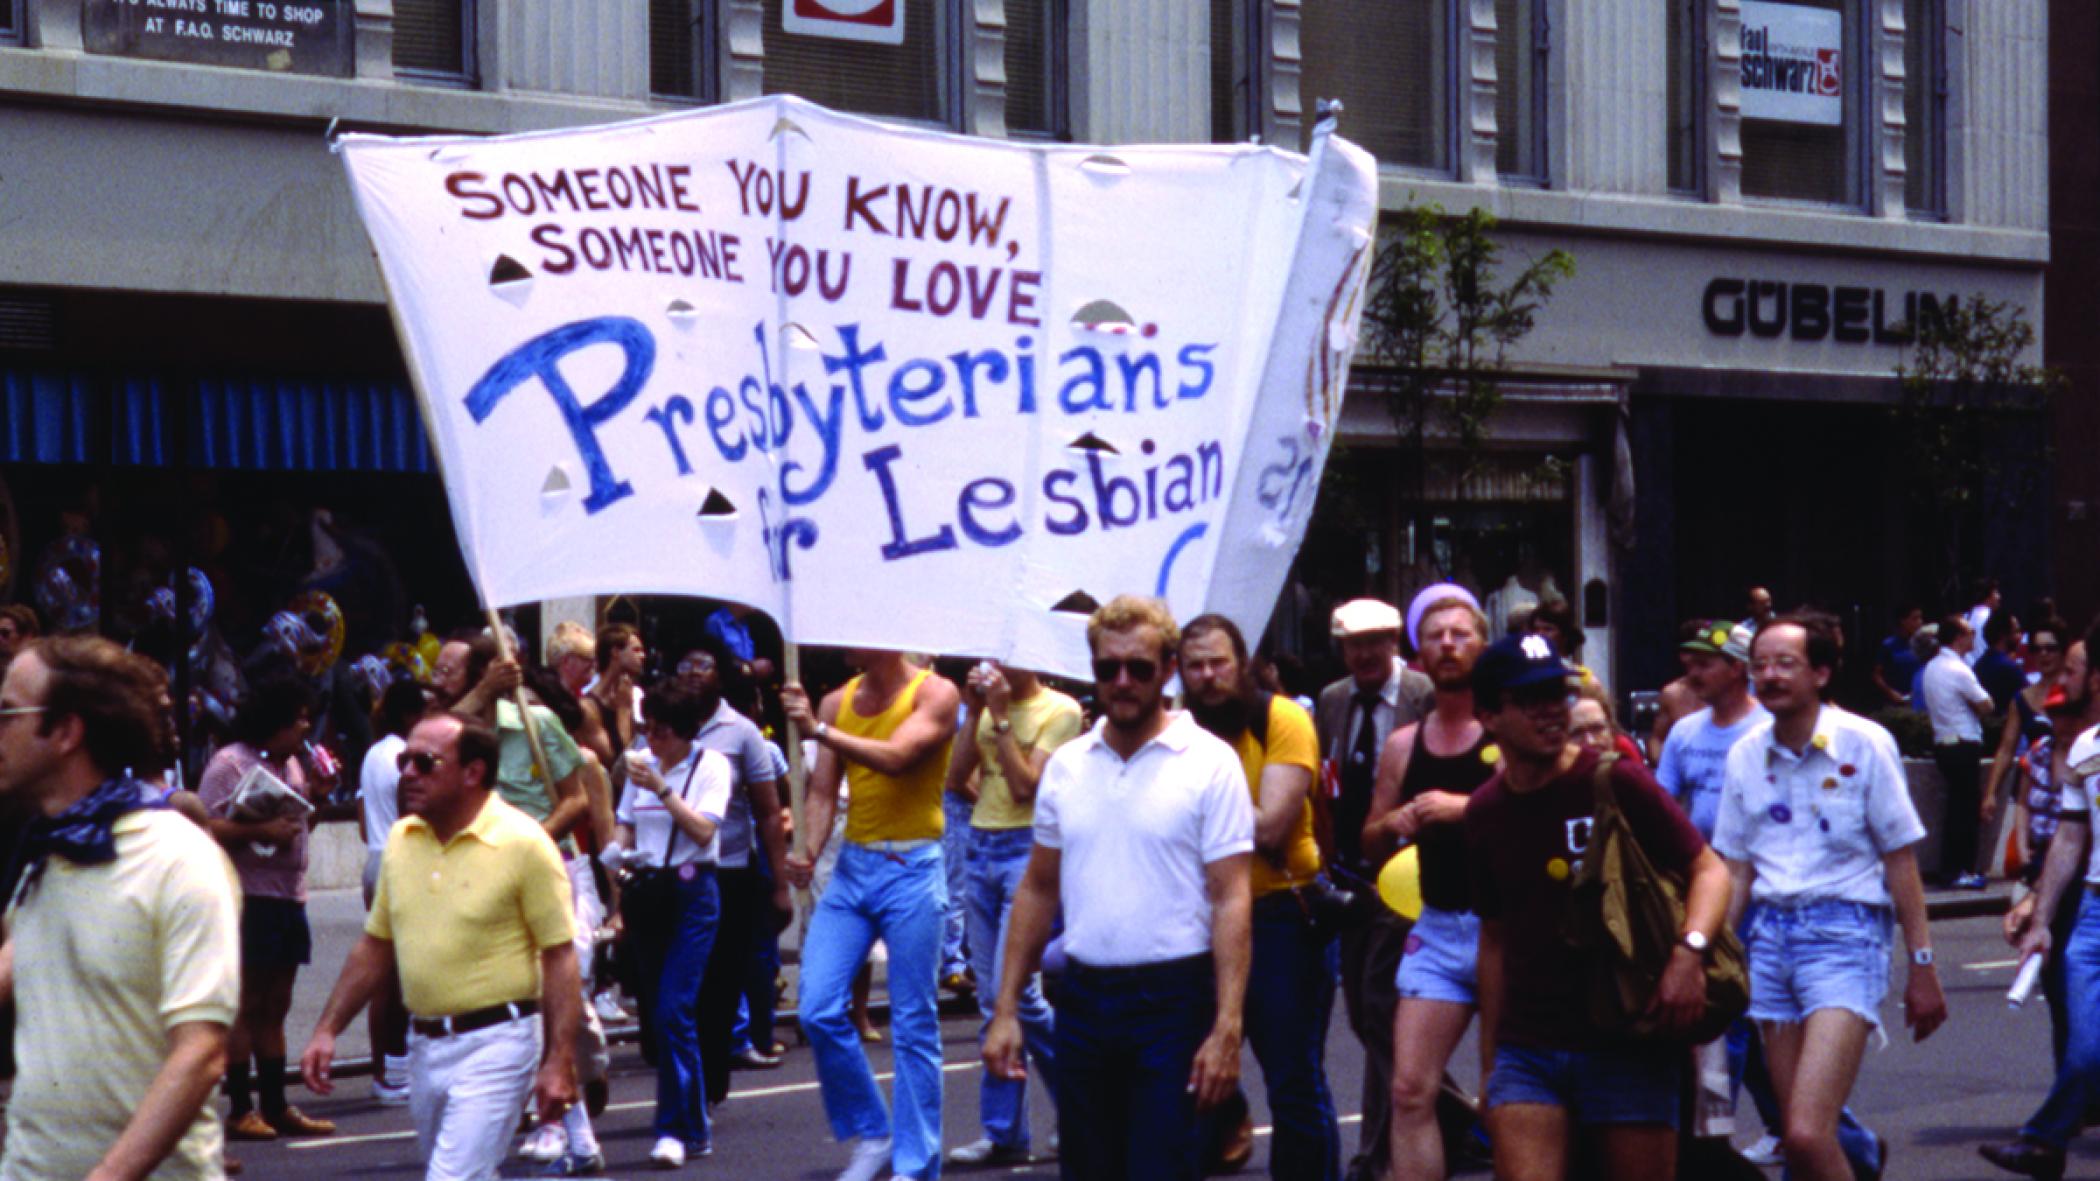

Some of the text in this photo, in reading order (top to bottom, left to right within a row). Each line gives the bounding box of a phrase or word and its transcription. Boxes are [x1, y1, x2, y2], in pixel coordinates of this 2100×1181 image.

[145, 16, 164, 33] AT
[222, 24, 295, 47] SCHWARZ
[215, 0, 249, 17] TIME
[257, 3, 277, 20] TO
[283, 6, 323, 24] SHOP
[445, 158, 1020, 262] SOMEONE YOU KNOW,
[530, 223, 1042, 328] SOMEONE YOU LOVE
[1702, 277, 1958, 348] GÜBELIN
[462, 315, 1220, 516] Presbyterians
[862, 439, 1224, 561] Lesbian
